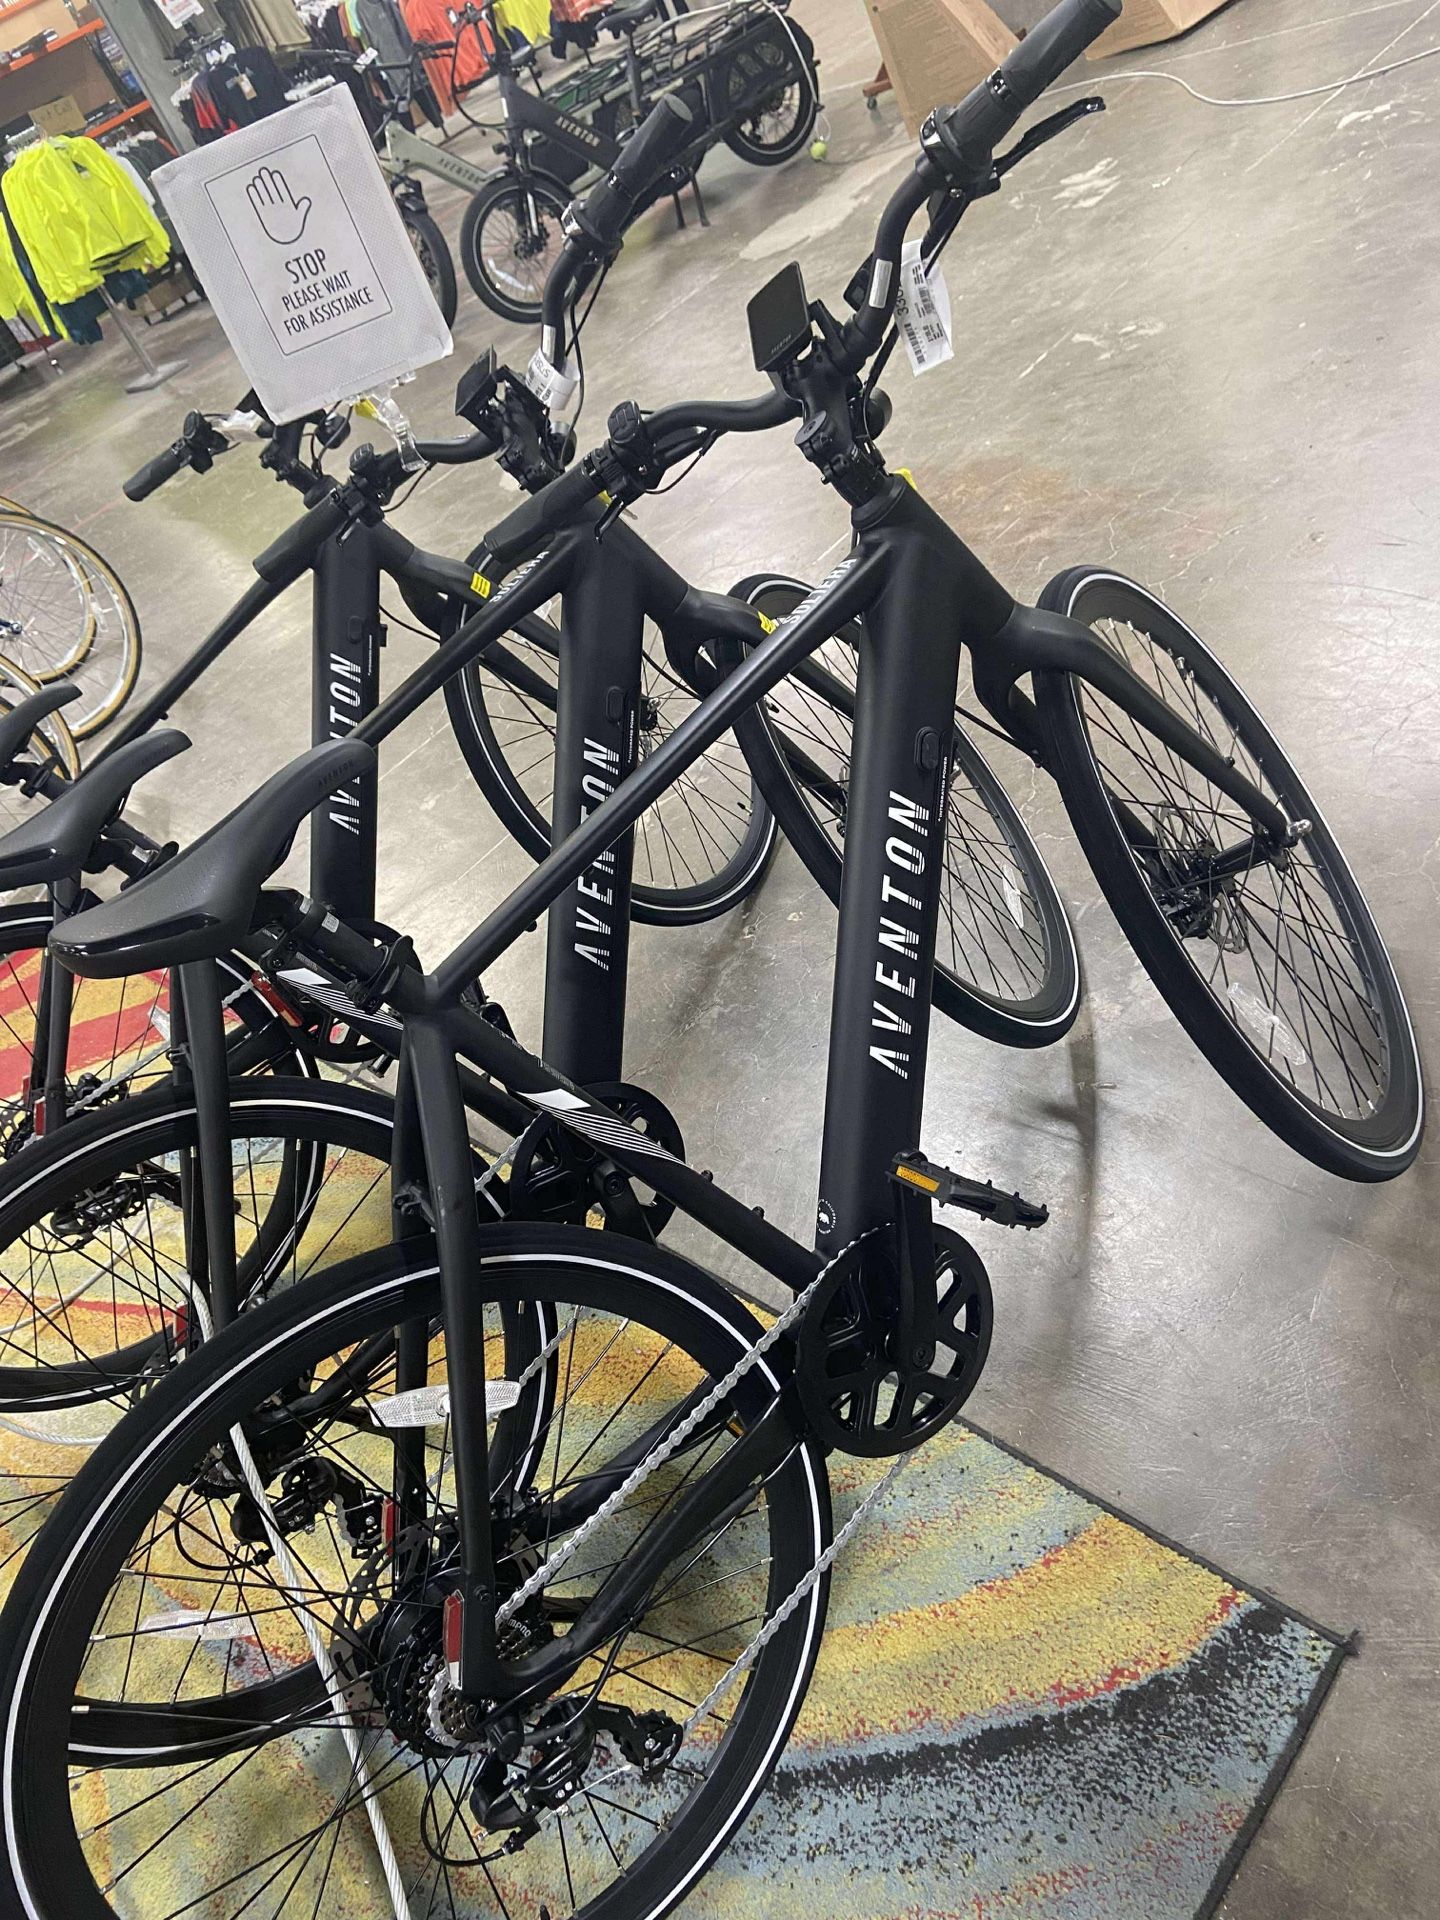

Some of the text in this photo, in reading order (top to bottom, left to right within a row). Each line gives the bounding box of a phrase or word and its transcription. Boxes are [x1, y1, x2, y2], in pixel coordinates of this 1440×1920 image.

[555, 115, 601, 148] AVENTON
[284, 248, 327, 285] STOP
[281, 270, 352, 313] PLEASE WAIT
[283, 286, 375, 336] FOR ASSISTANCE
[329, 652, 362, 836] AVTON
[938, 779, 946, 818] INTEGRATED
[869, 790, 930, 1080] AVENTON
